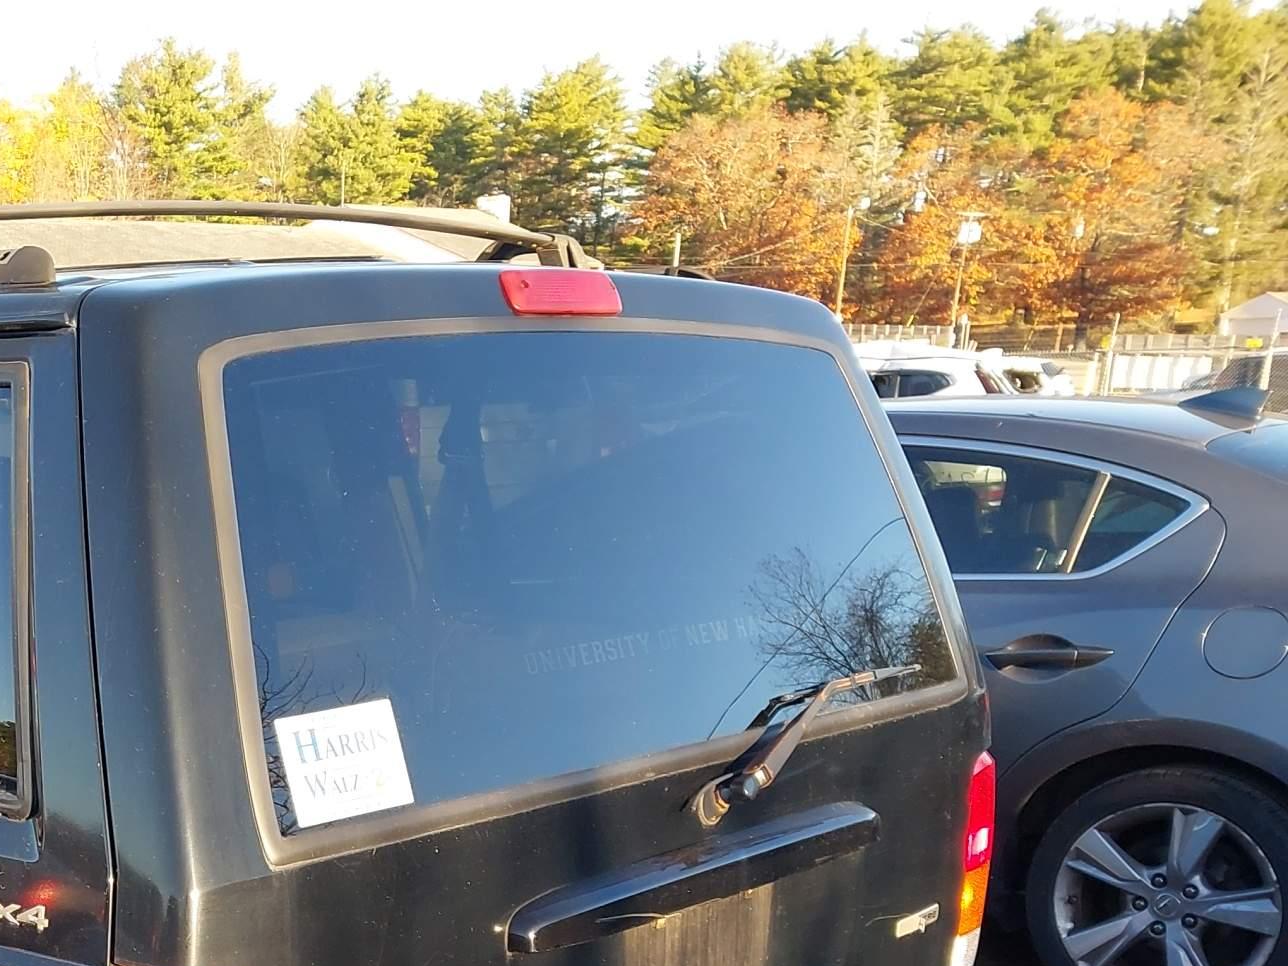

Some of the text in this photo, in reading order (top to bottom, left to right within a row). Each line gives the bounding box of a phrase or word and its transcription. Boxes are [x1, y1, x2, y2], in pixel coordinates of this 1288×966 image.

[522, 631, 650, 674] UNIVERSITY
[684, 619, 729, 647] NEW
[292, 727, 389, 764] HARRIS
